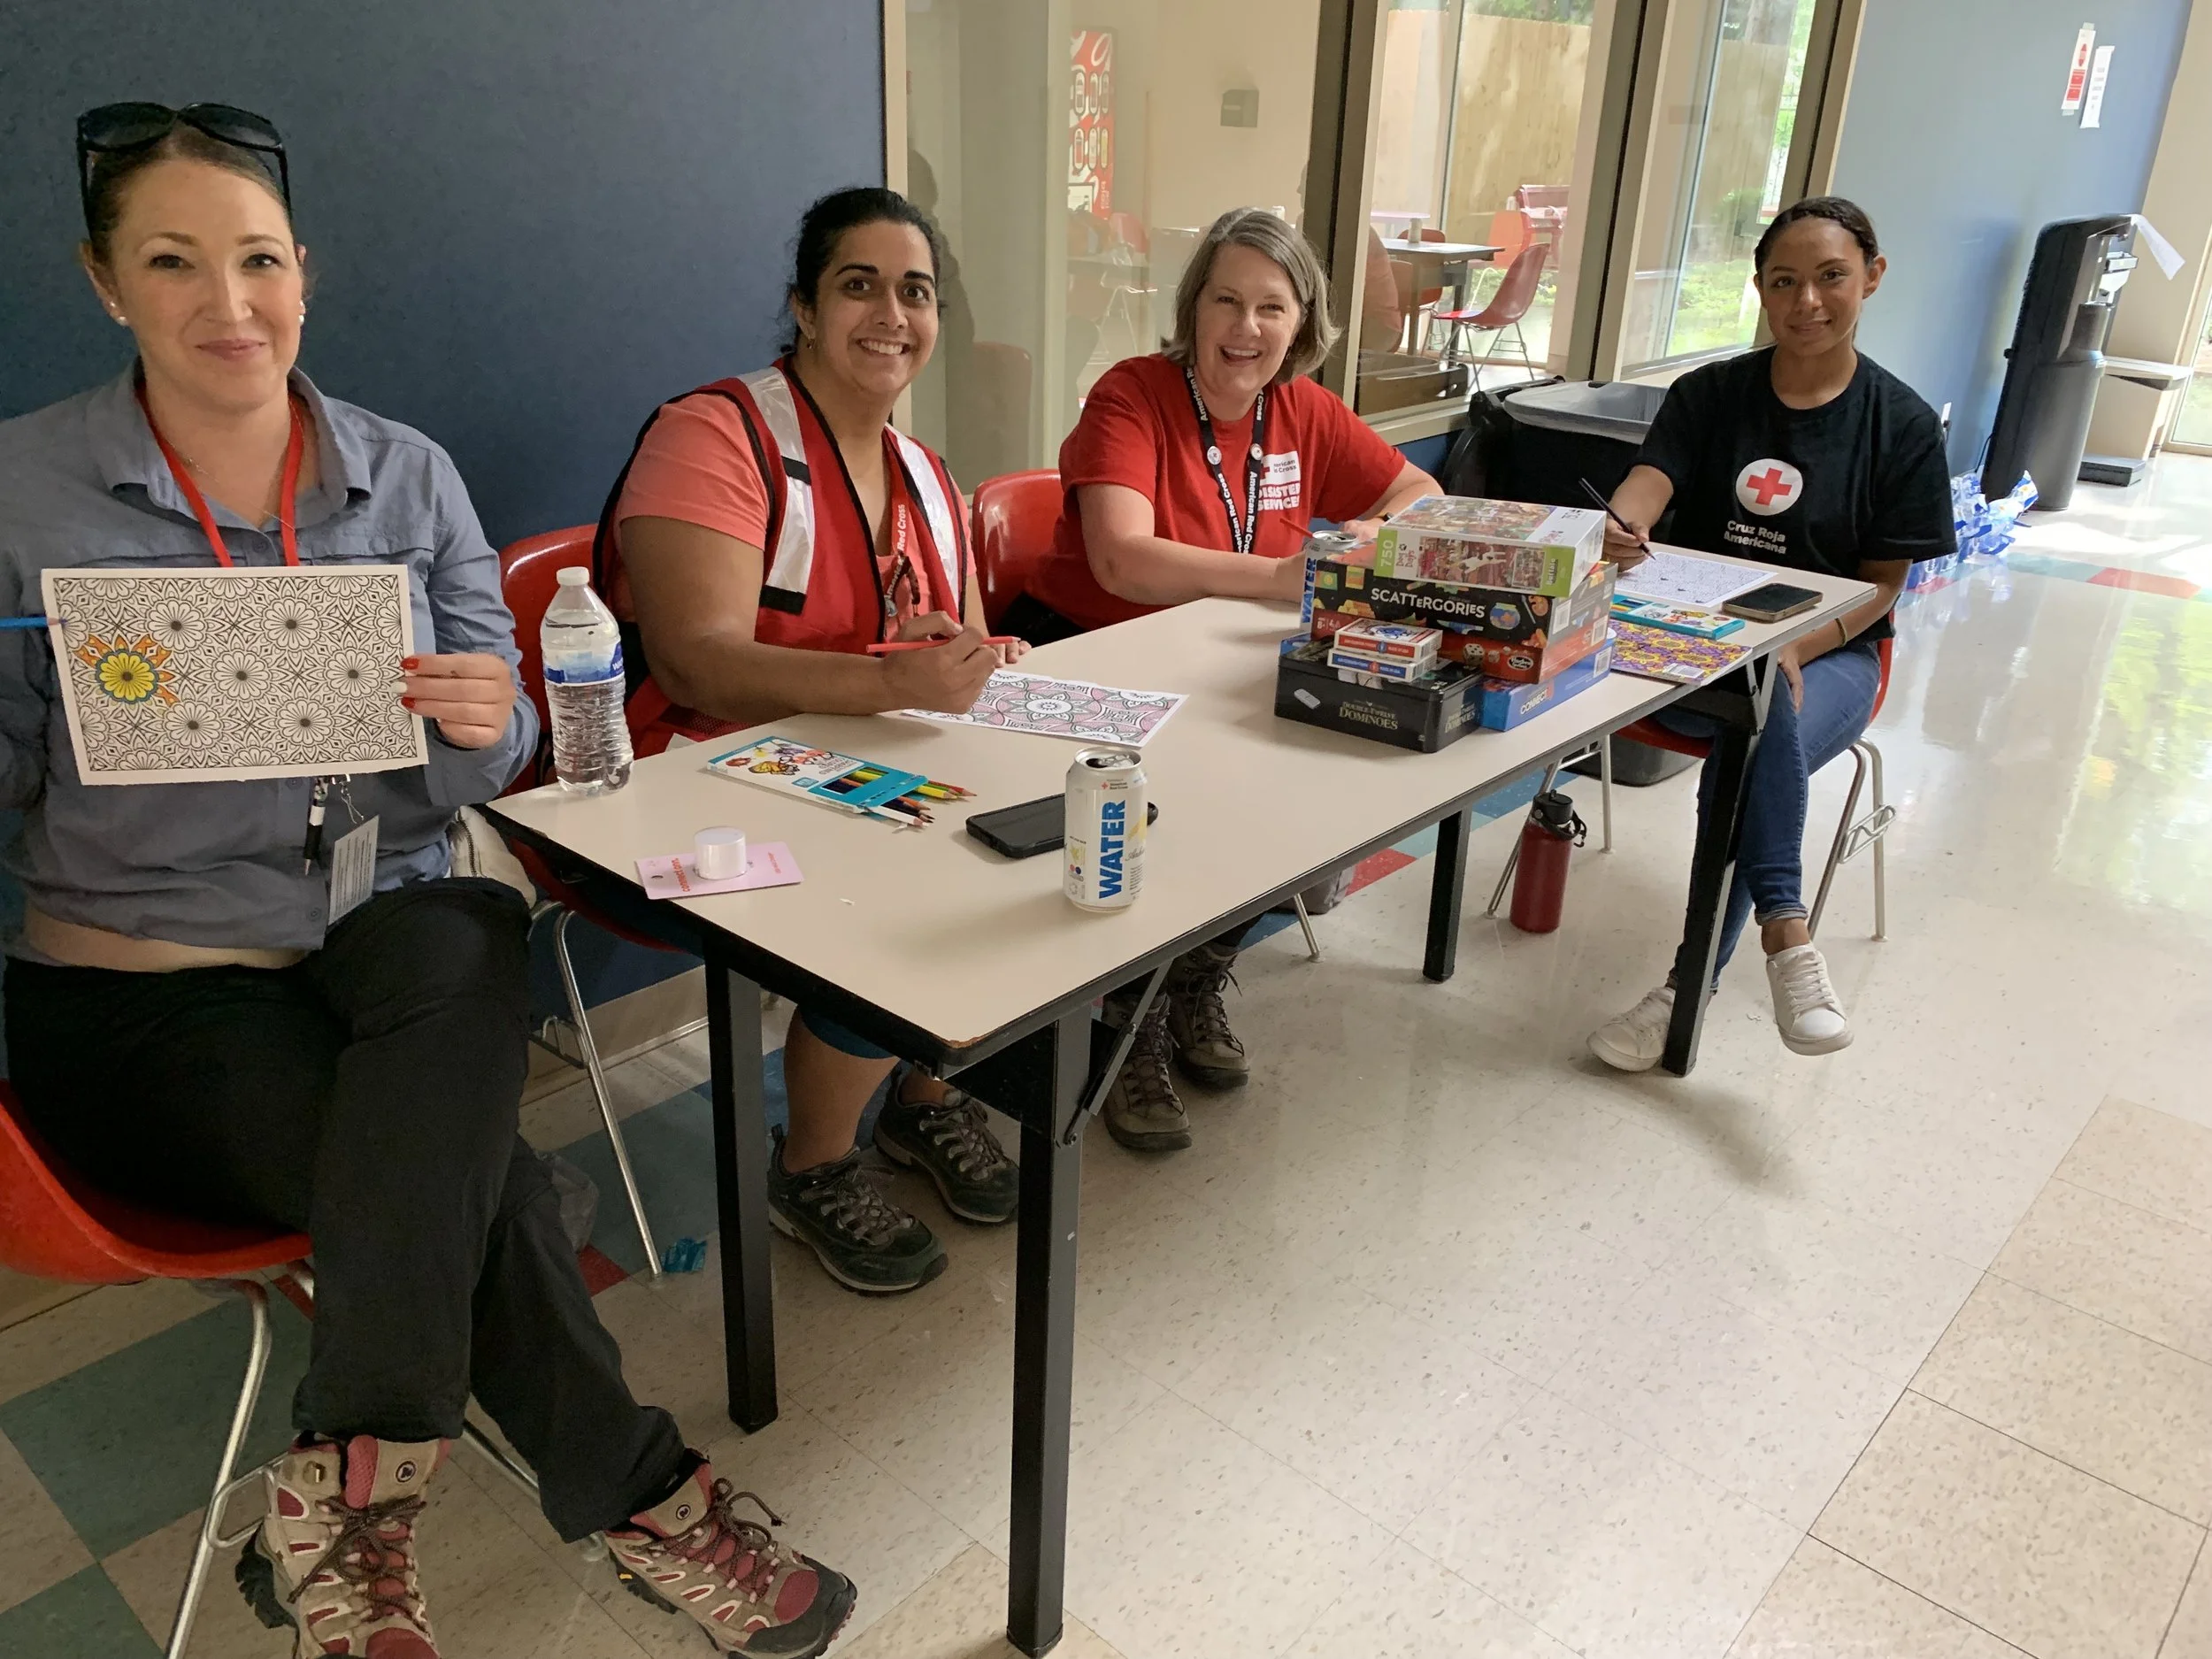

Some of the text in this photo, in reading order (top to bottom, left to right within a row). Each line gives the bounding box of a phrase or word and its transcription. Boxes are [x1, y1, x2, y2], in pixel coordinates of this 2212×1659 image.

[1190, 378, 1209, 421] American
[1256, 395, 1264, 421] Cross
[1257, 495, 1300, 511] SERVICE
[1258, 482, 1301, 499] DISSTE
[897, 503, 906, 530] Cross
[1217, 472, 1242, 553] merican Red Cross
[1243, 471, 1258, 554] American Red Cros
[897, 530, 906, 551] Red
[1724, 530, 1787, 555] Americana
[1727, 519, 1786, 542] Cruz Roja
[1379, 539, 1394, 567] 750
[1302, 557, 1317, 623] WATER
[1371, 588, 1486, 618] SCATTERGORIES
[1339, 706, 1399, 730] DOMINOES
[1098, 799, 1125, 899] WATER
